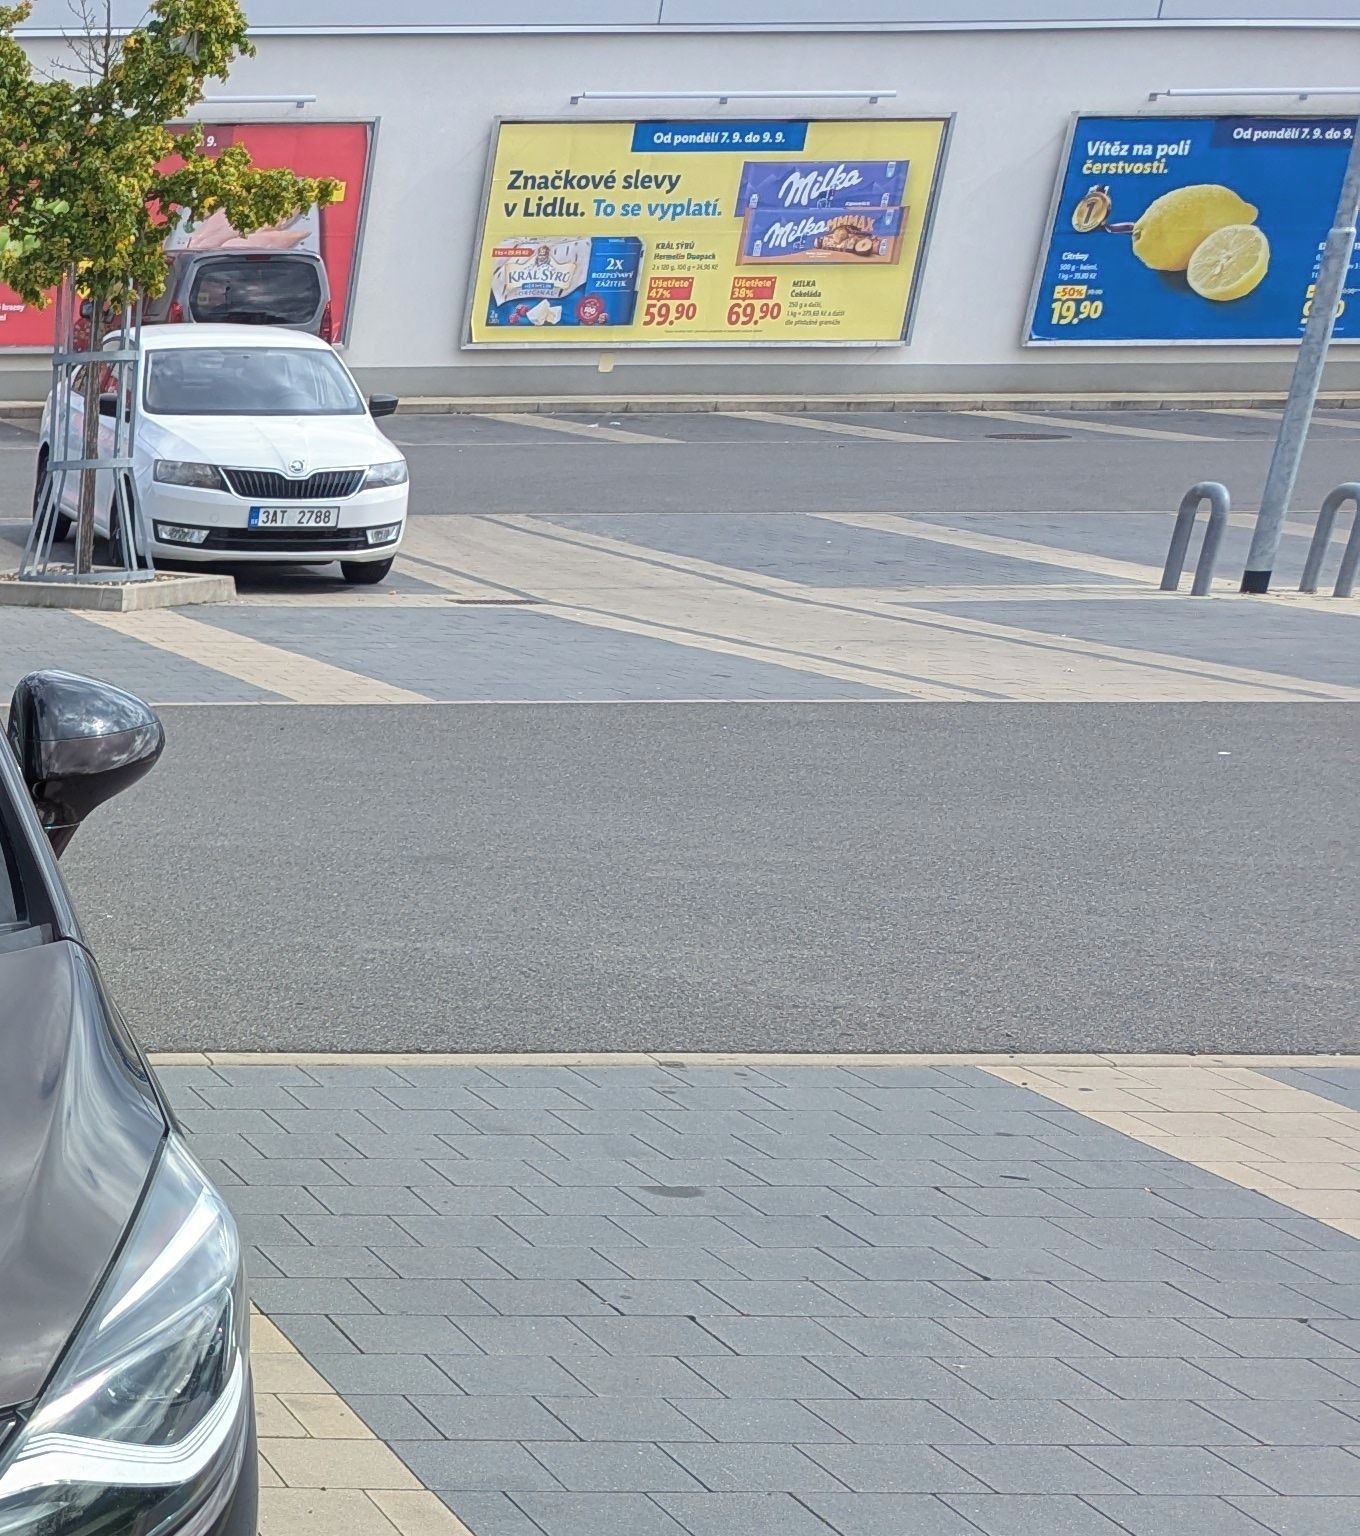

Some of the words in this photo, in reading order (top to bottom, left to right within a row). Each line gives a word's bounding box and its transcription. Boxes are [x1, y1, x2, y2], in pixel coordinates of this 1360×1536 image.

[654, 132, 671, 143] Od
[674, 131, 719, 146] pondělí
[720, 132, 729, 143] 7.
[732, 132, 742, 143] 9.
[745, 132, 760, 143] do
[762, 132, 772, 143] 9.
[775, 132, 785, 143] 9.
[1233, 128, 1252, 139] Od
[1253, 128, 1299, 141] pondělí
[1301, 128, 1310, 139] 7.
[1312, 128, 1322, 139] 9.
[1325, 128, 1341, 139] do
[1343, 128, 1353, 139] 9.
[1087, 141, 1129, 156] Vítěz
[1132, 144, 1153, 155] na
[1156, 140, 1191, 159] poli
[1083, 159, 1168, 174] čerstvosti.
[507, 170, 617, 190] Značkové
[622, 169, 681, 194] slevy
[779, 164, 863, 207] Milka
[504, 203, 518, 217] v
[523, 196, 585, 217] Lidlu.
[593, 199, 616, 217] To
[620, 203, 641, 217] se
[648, 198, 722, 221] vyplatí.
[764, 216, 828, 249] Milka
[649, 288, 671, 299] 47%
[732, 288, 754, 299] 38%
[1056, 287, 1084, 298] -50%
[643, 303, 697, 326] 59.90
[727, 303, 781, 326] 69.90
[1051, 300, 1103, 325] 19.90
[262, 510, 287, 524] 3AT
[297, 510, 332, 525] 2788
